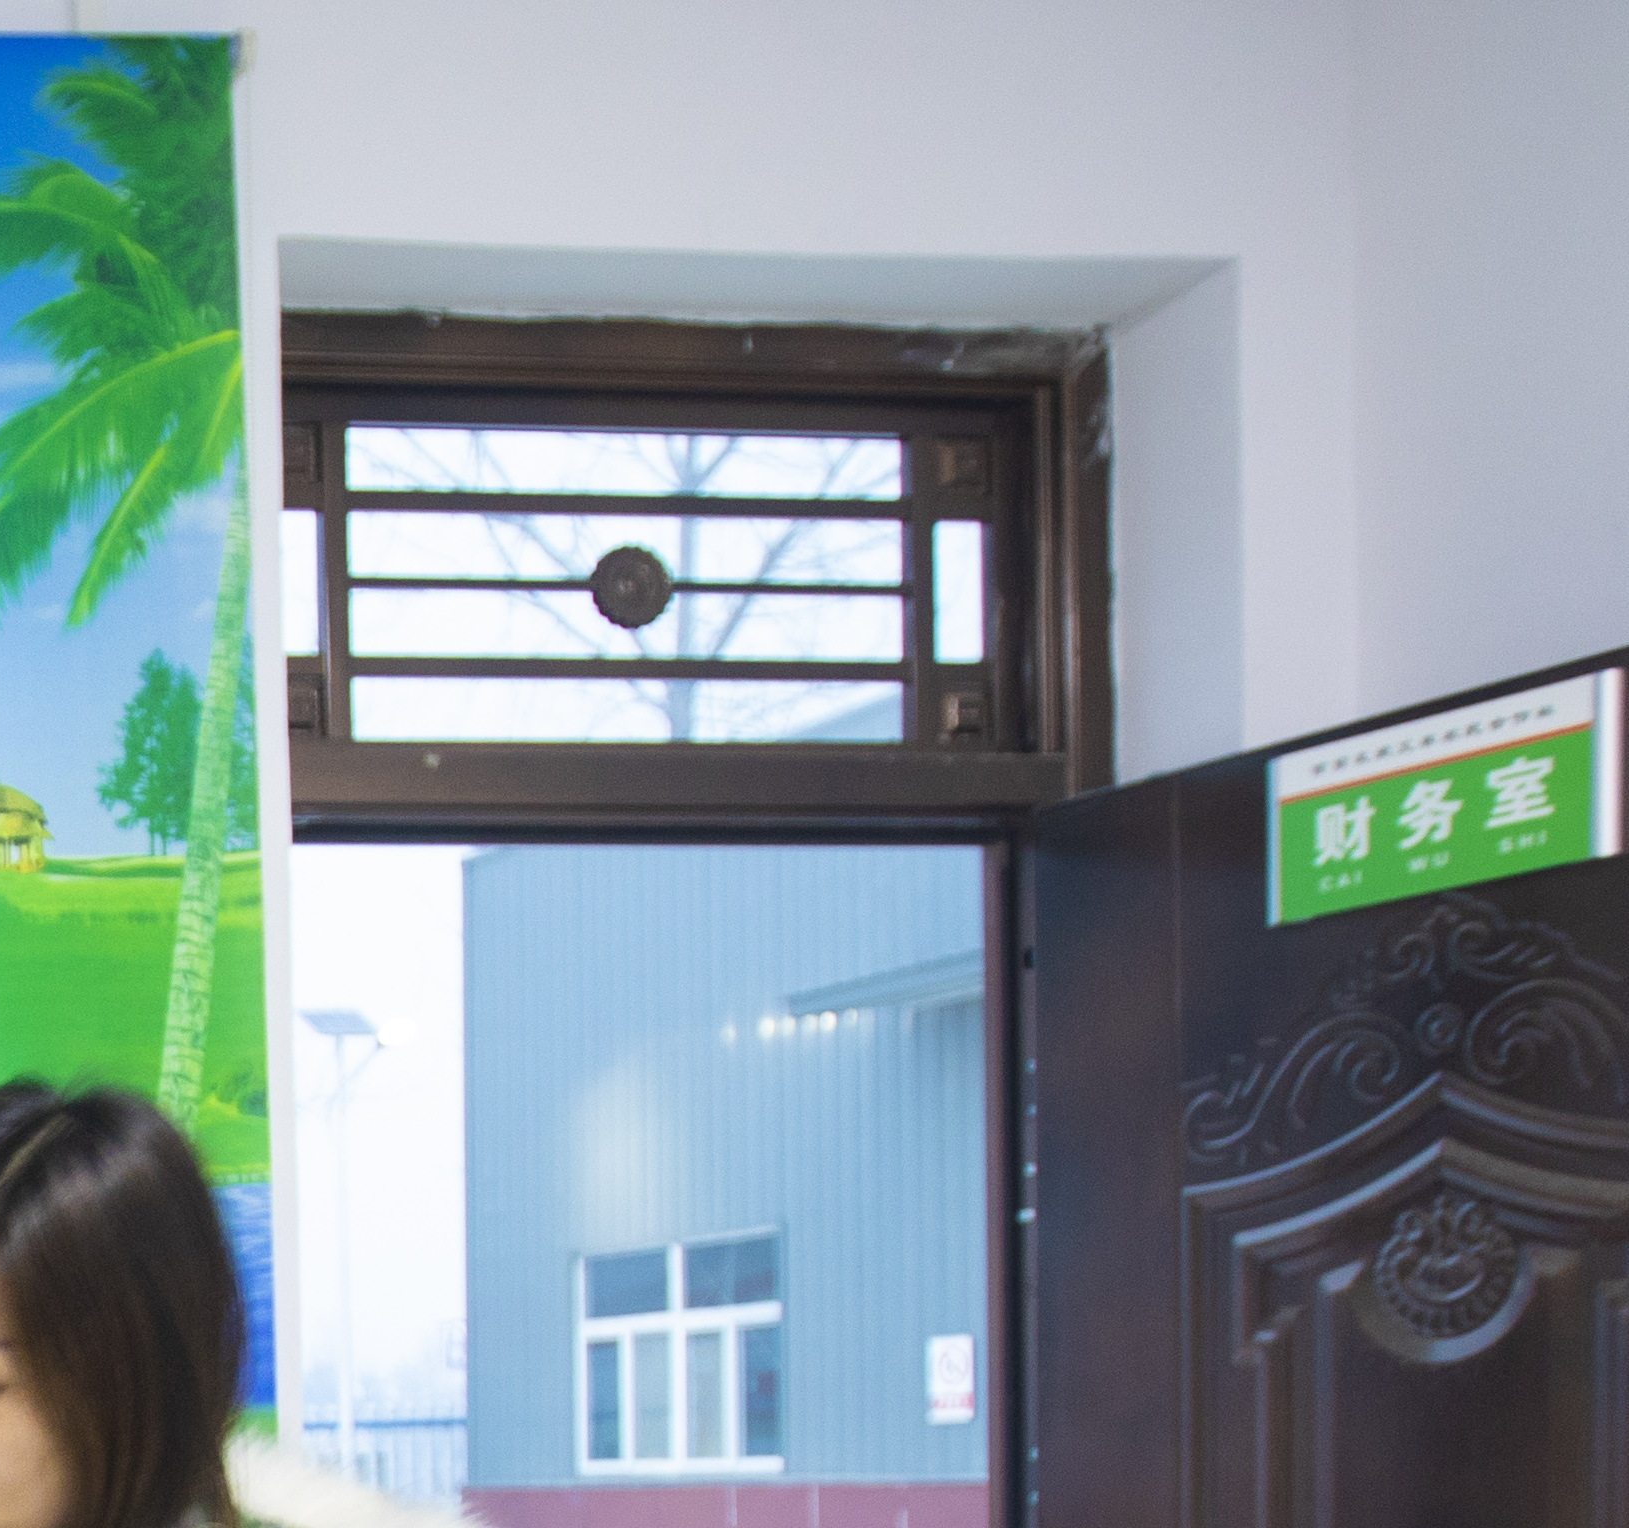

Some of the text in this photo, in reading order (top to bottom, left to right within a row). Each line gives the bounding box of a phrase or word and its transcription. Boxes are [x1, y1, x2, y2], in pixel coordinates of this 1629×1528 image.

[1313, 756, 1556, 867] 财务室
[1318, 830, 1549, 893] CAI WU SHI
